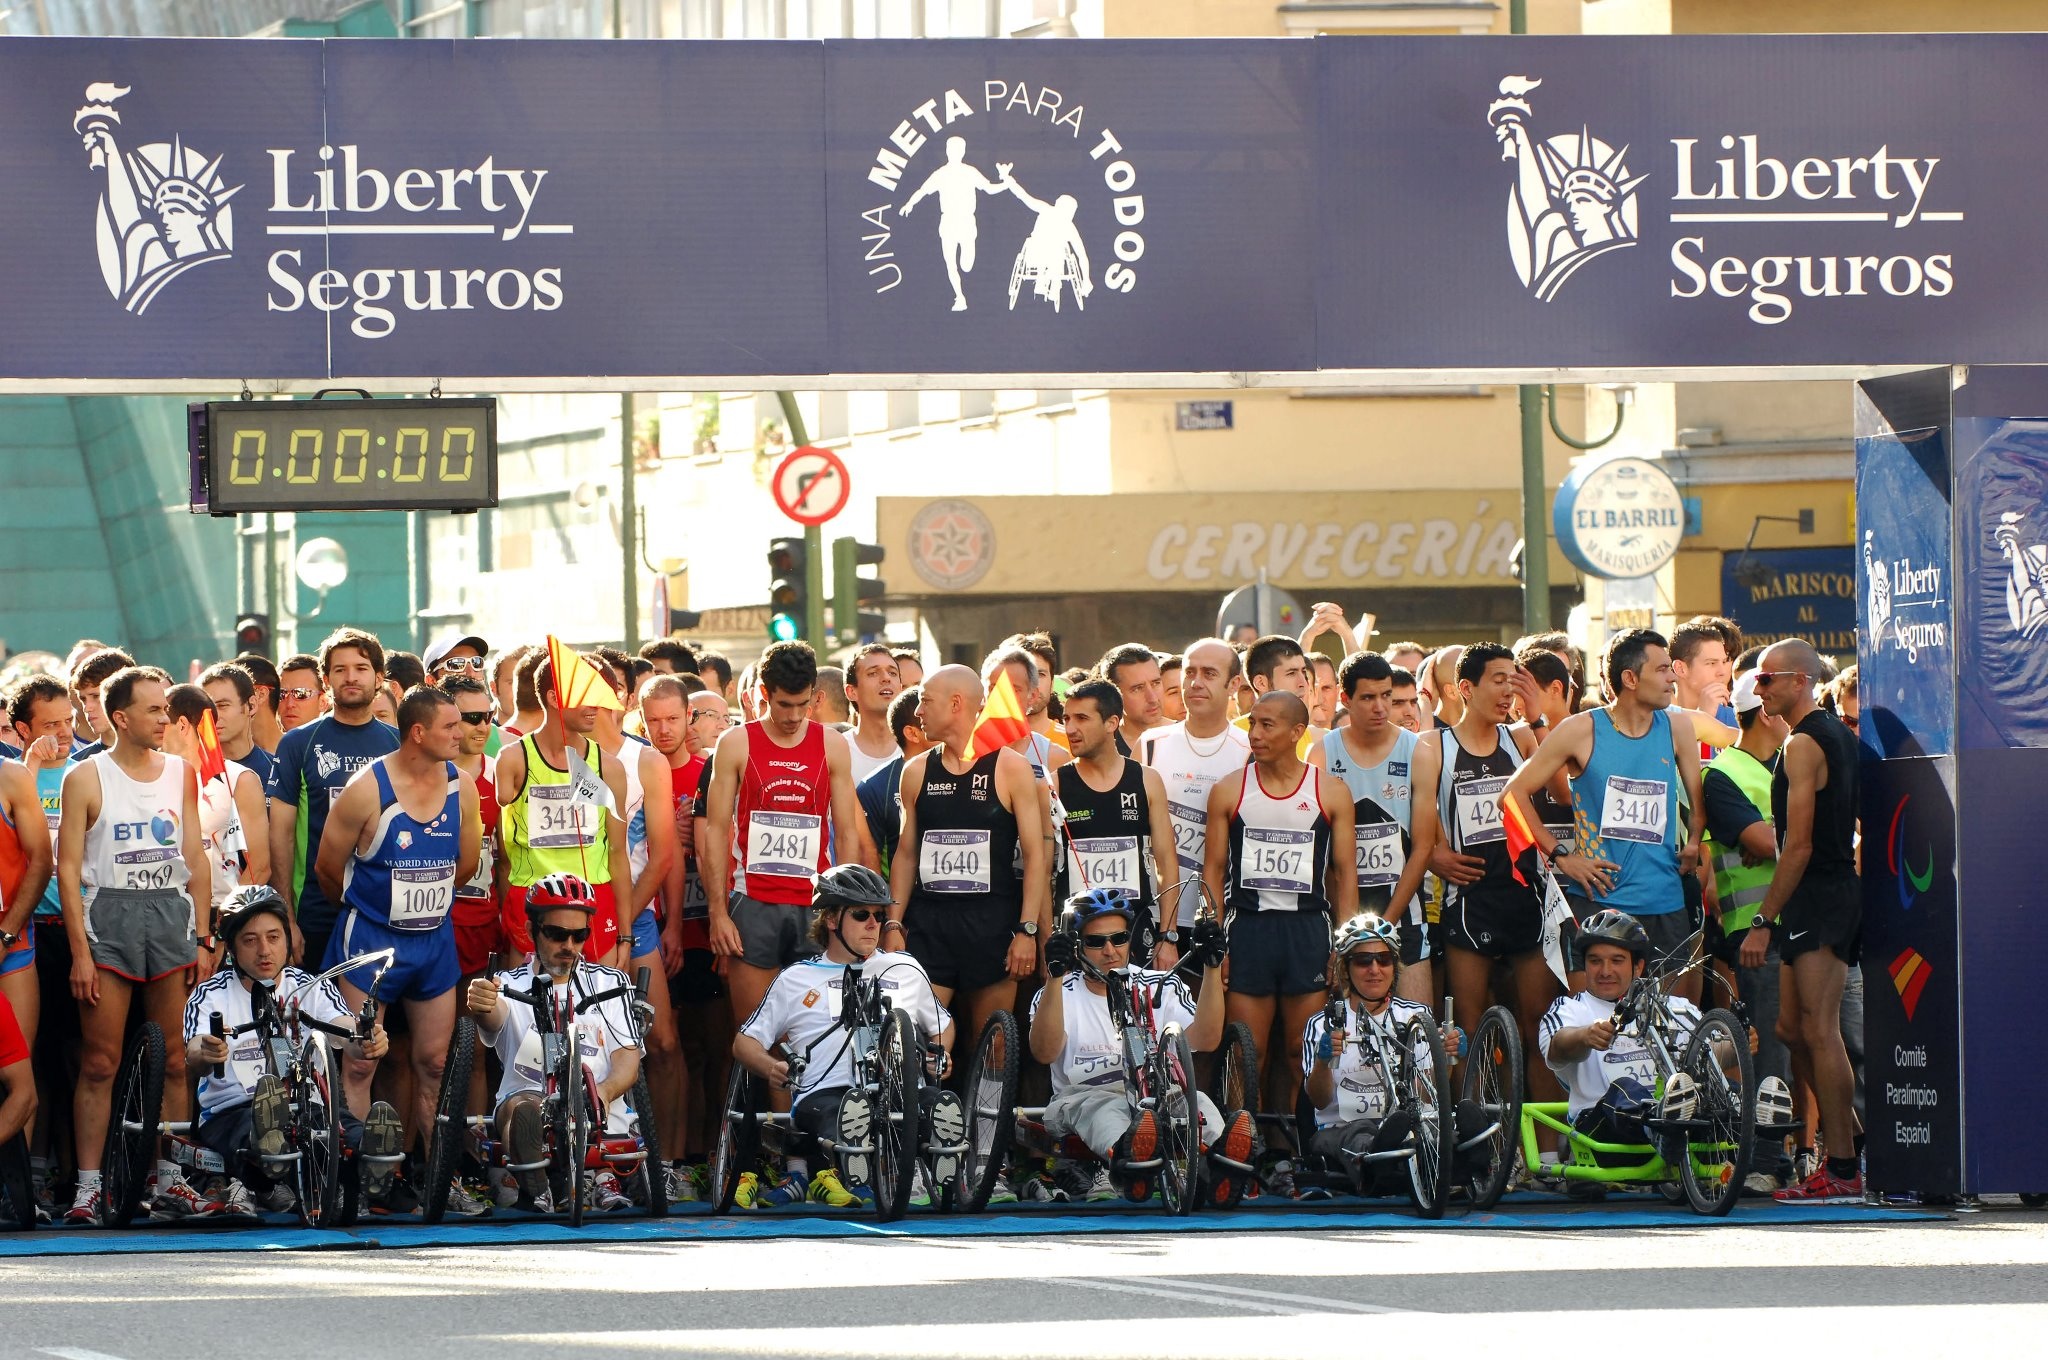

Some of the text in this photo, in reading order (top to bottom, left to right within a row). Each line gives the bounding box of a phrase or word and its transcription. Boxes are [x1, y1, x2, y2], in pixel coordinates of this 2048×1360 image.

[267, 145, 549, 241] Liberty
[862, 80, 1145, 293] UNA META PARA TODOS
[1670, 135, 1940, 228] Liberty
[267, 250, 564, 339] Seguros
[1670, 237, 1953, 325] Seguros
[1577, 508, 1679, 528] EL BARRIL
[1146, 500, 1518, 581] CERVECERÍA
[1751, 573, 1857, 603] MARISCO
[1893, 558, 1941, 608] Liberty
[1797, 605, 1818, 622] AL
[1894, 616, 1944, 664] Seguros
[768, 760, 801, 769] saucony
[764, 779, 792, 793] running
[774, 794, 805, 803] running
[540, 804, 588, 830] 3411
[773, 820, 801, 828] LIBERTY
[1612, 798, 1659, 826] 3410
[114, 822, 148, 841] BT
[760, 832, 808, 859] 2481
[384, 860, 421, 868] MADRID
[931, 851, 979, 875] 1640
[1081, 858, 1128, 884] 1641
[1253, 848, 1302, 875] 1567
[127, 864, 173, 890] 5969
[403, 886, 446, 913] 1002
[1895, 1045, 1927, 1067] Comité
[1356, 1095, 1384, 1114] 34
[1886, 1083, 1937, 1110] Paralímpico
[1896, 1121, 1930, 1148] Español
